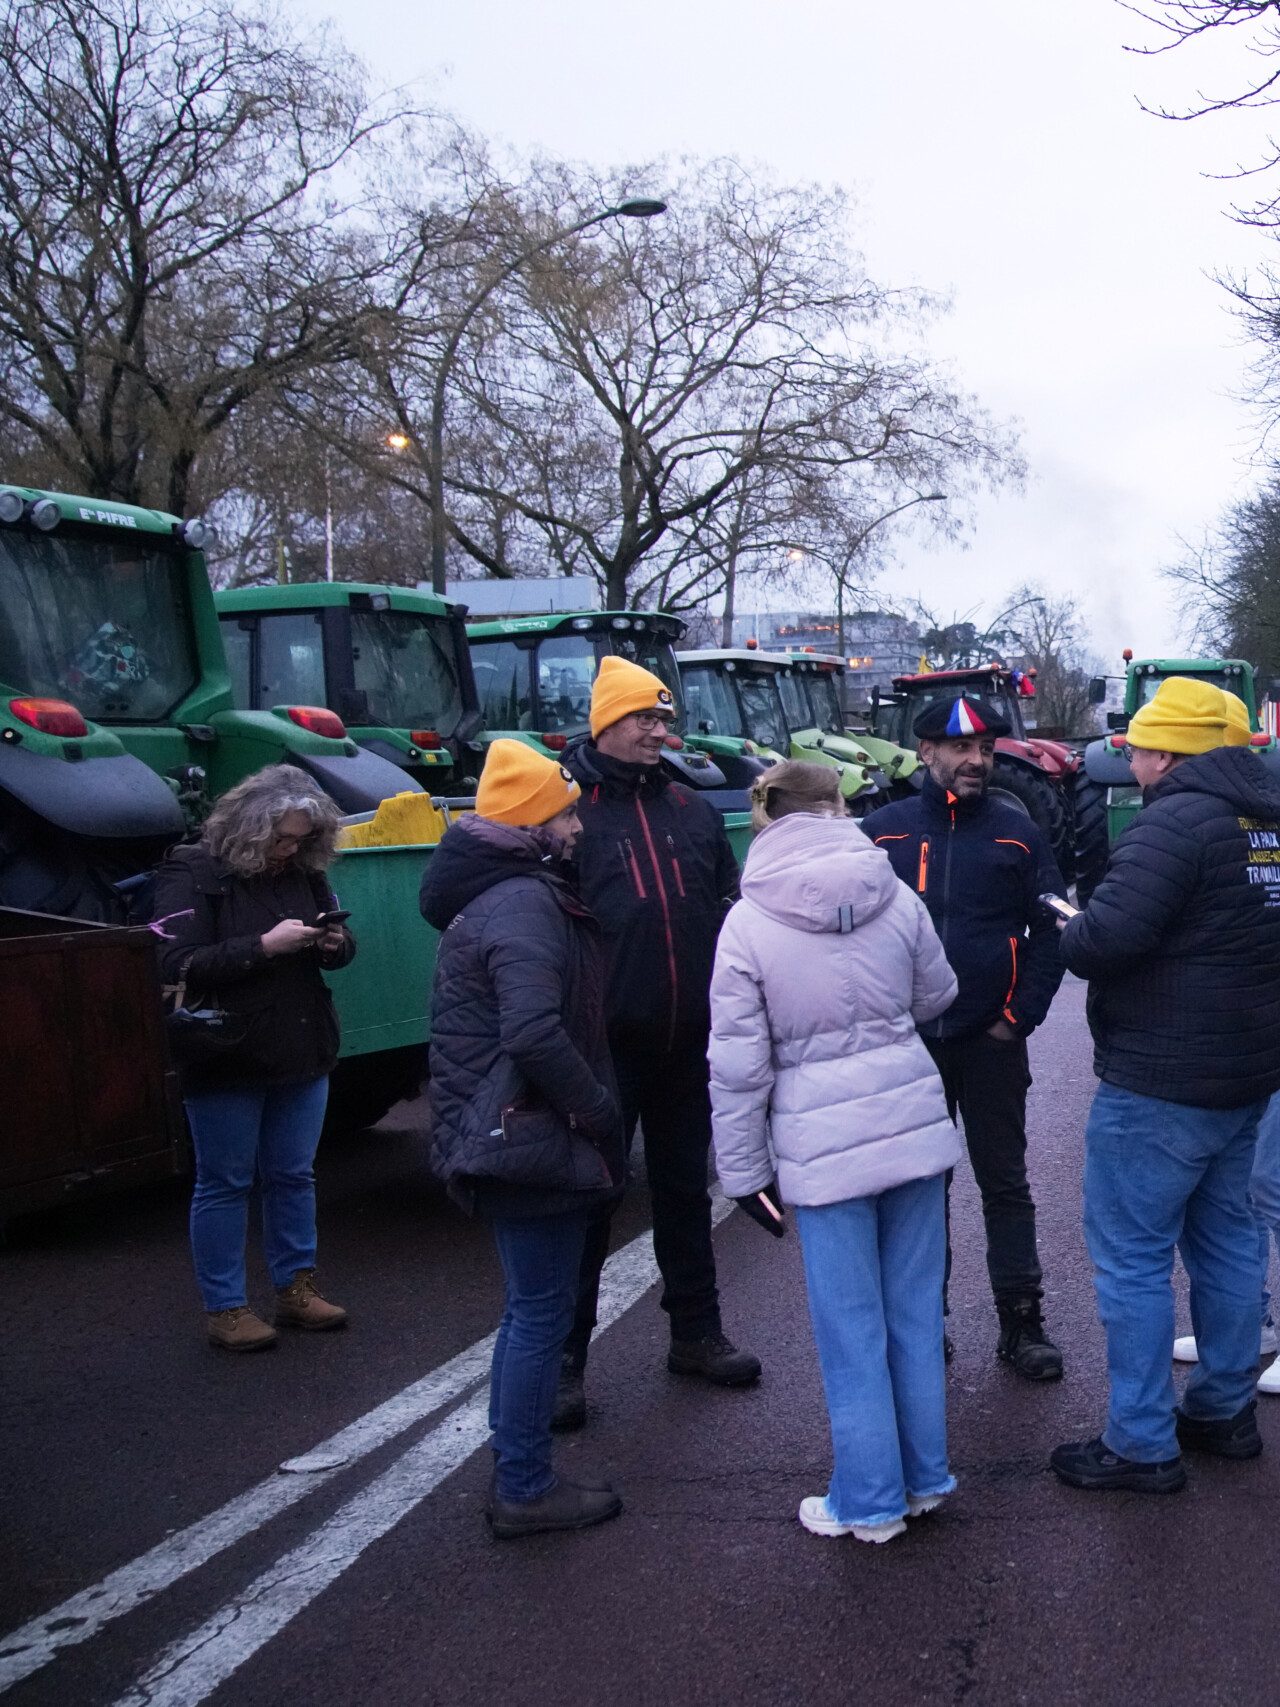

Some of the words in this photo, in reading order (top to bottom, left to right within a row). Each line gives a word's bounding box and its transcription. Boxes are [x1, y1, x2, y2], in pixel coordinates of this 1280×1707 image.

[96, 510, 137, 528] PIFRE
[1247, 831, 1260, 848] LA
[1260, 831, 1280, 849] PAIX
